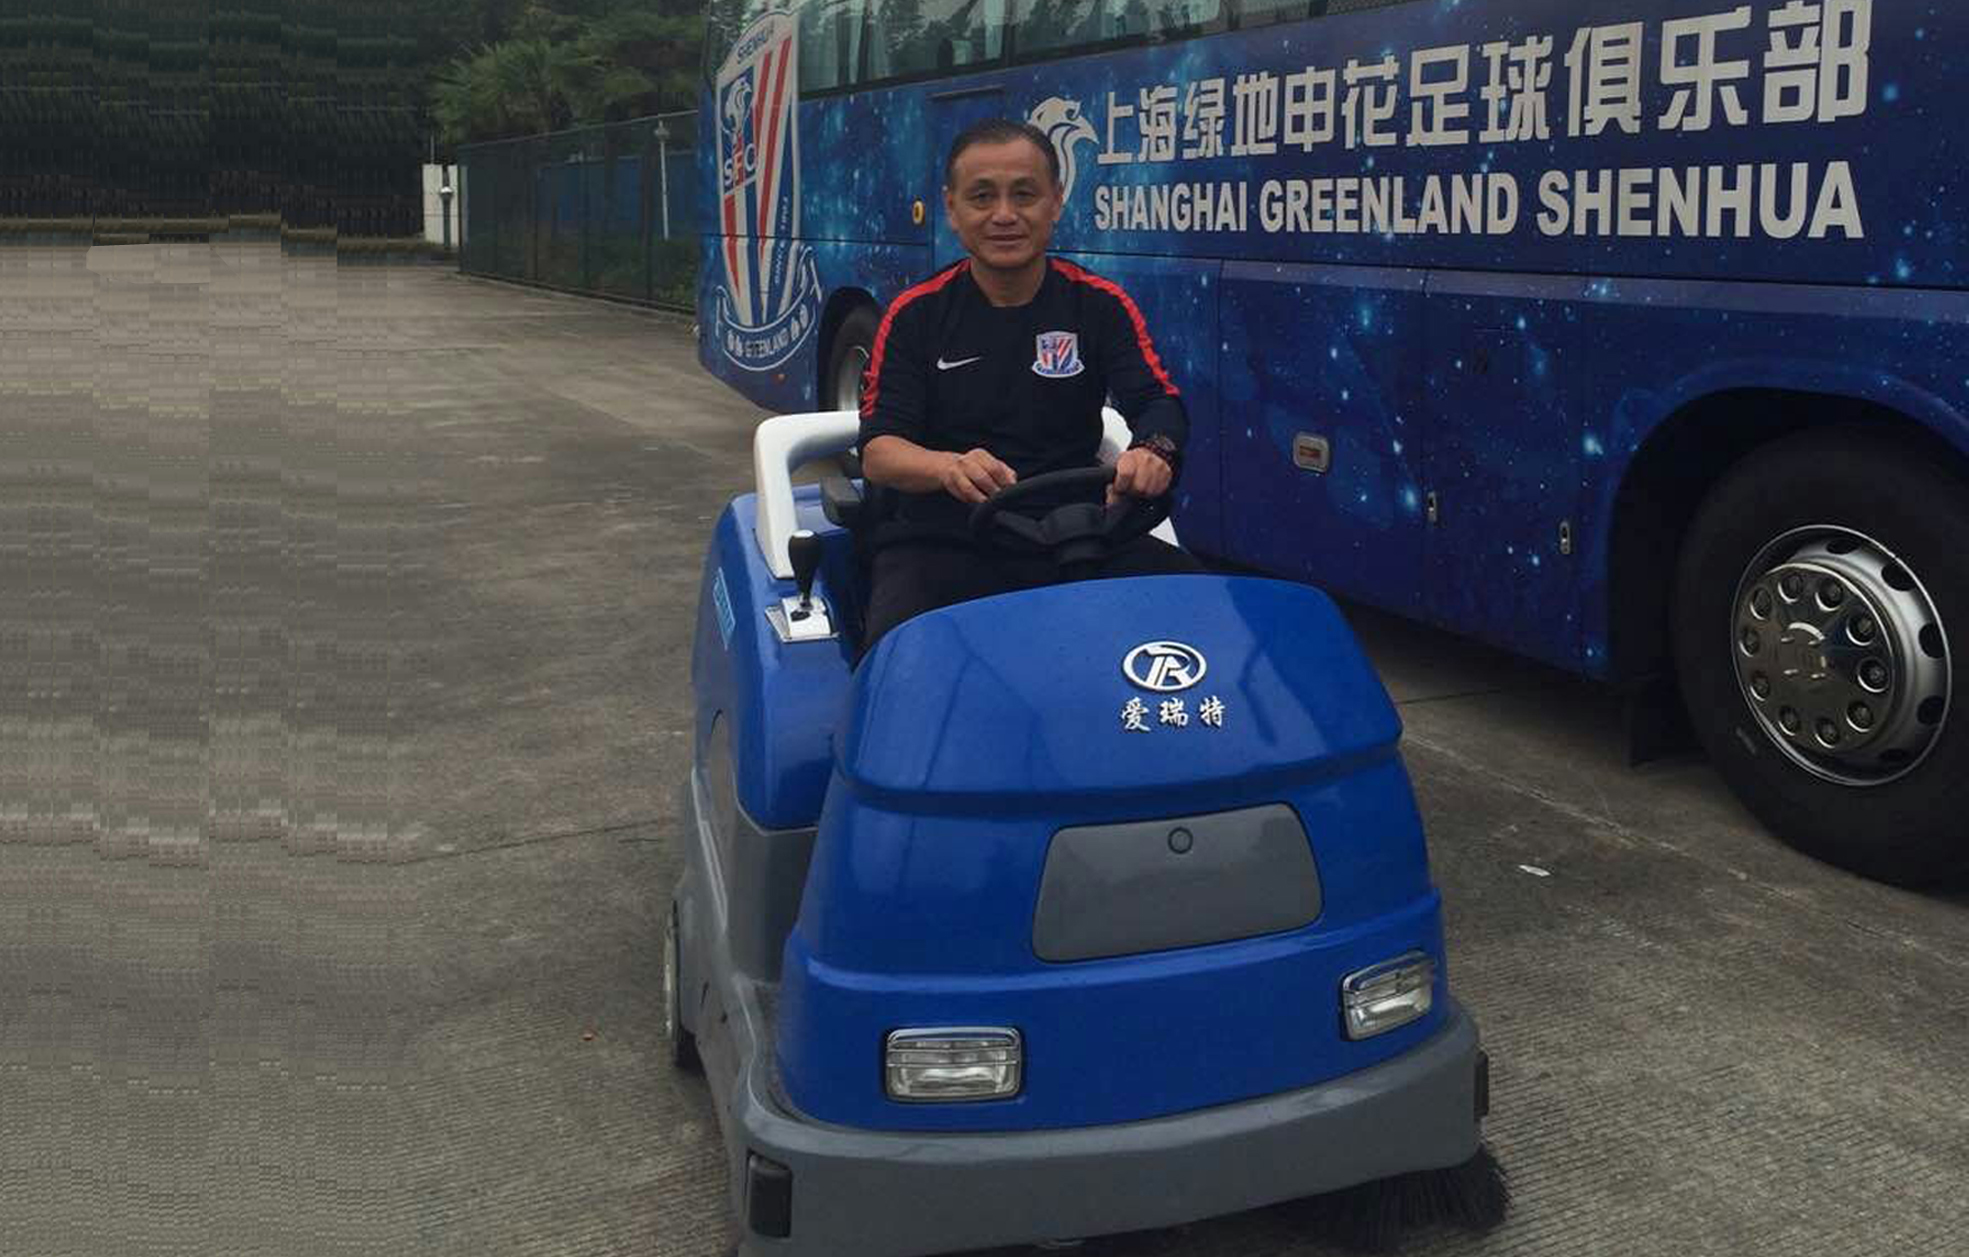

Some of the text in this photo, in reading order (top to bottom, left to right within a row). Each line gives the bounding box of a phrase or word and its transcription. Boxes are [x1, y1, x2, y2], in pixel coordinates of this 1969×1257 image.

[1097, 0, 1873, 165] 上海绿地申花足球俱乐部
[1094, 160, 1865, 239] SHANGHAI GREENLAND SHENHUA
[1120, 695, 1226, 732] 爱瑞特
